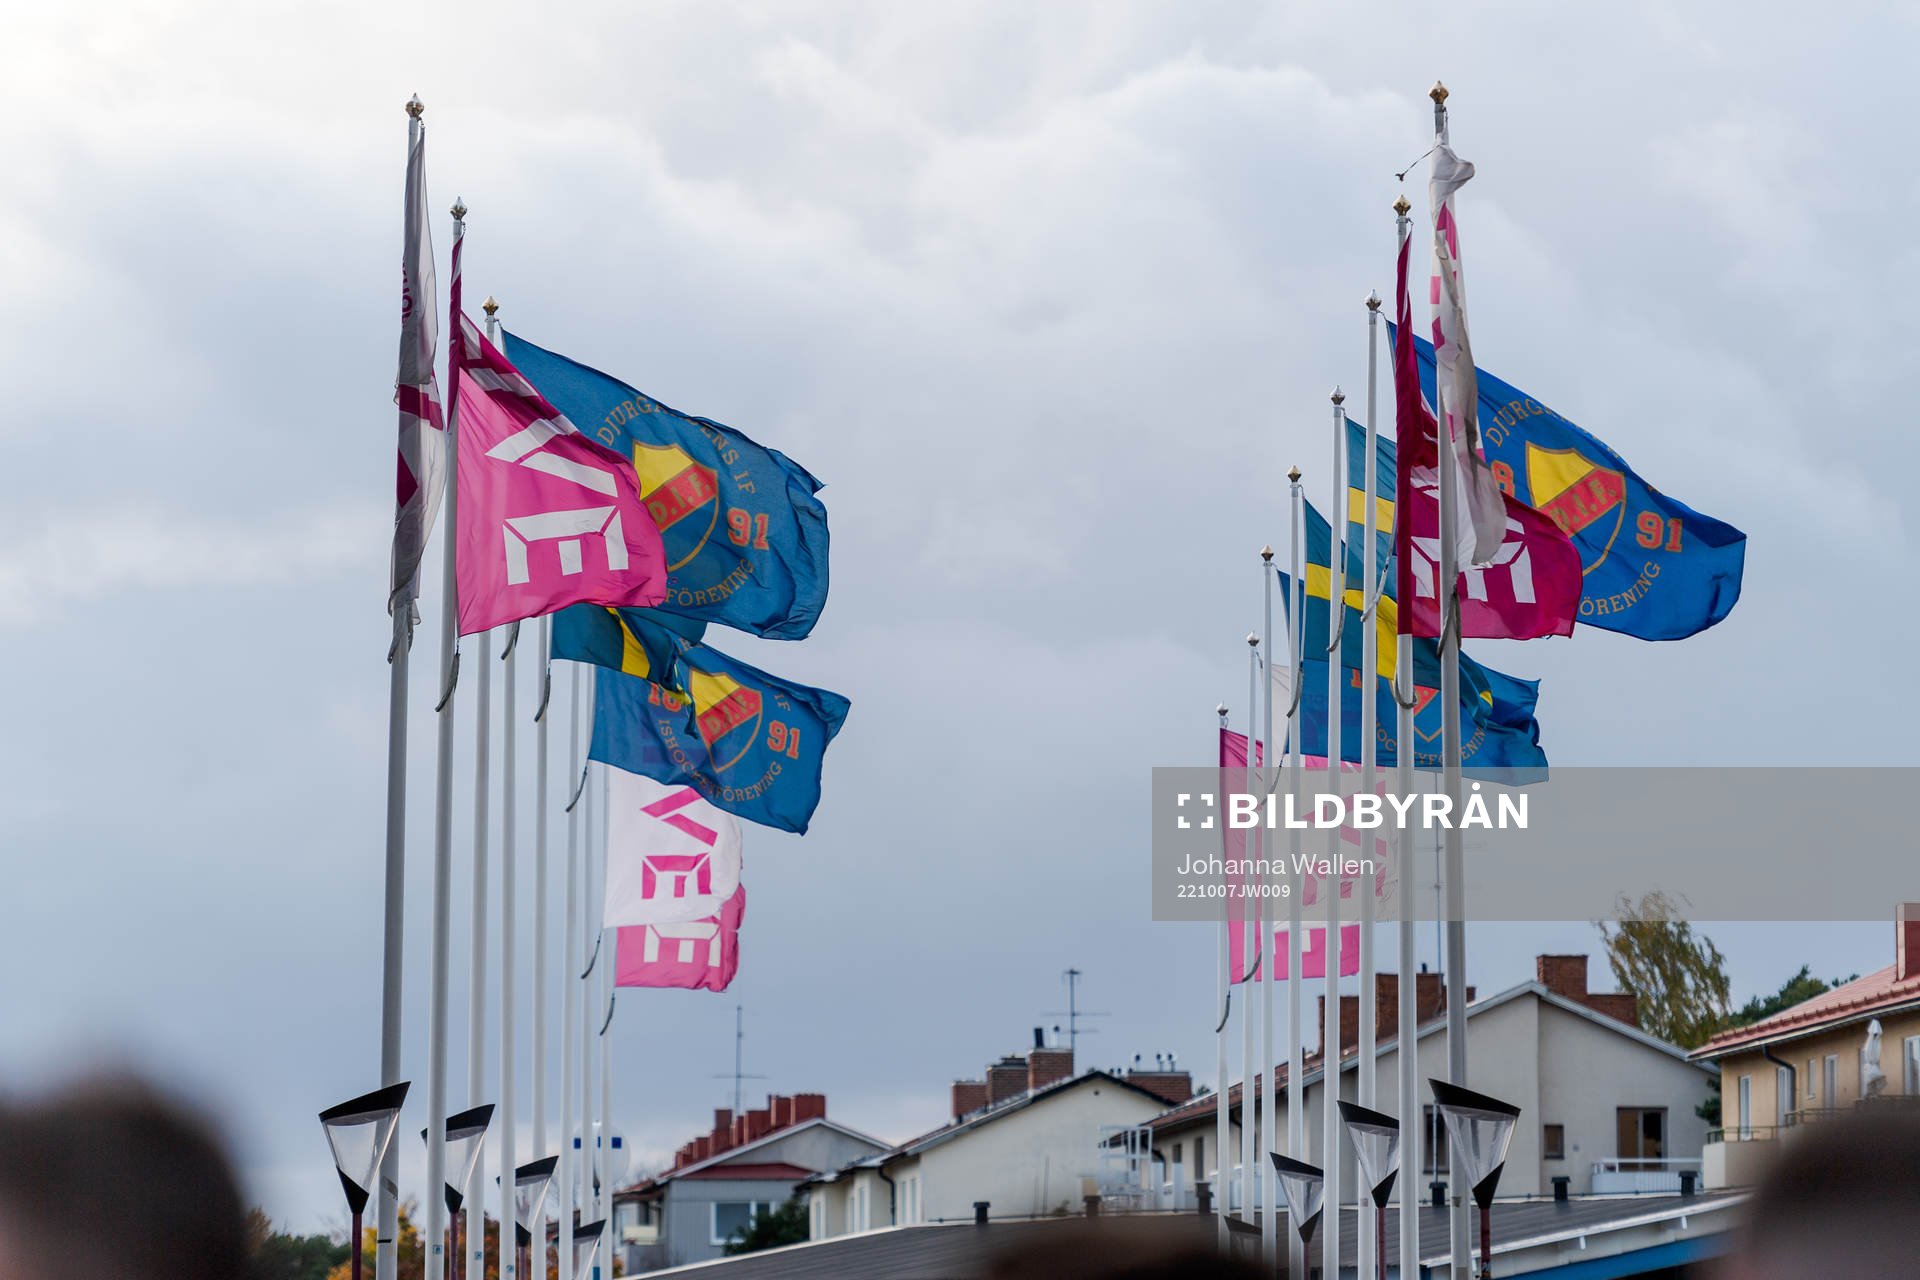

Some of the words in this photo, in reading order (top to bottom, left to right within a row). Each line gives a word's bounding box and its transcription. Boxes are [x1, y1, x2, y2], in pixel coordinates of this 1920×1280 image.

[734, 470, 756, 494] IF
[727, 507, 769, 550] 91
[1636, 511, 1682, 552] 91
[767, 720, 800, 759] 91
